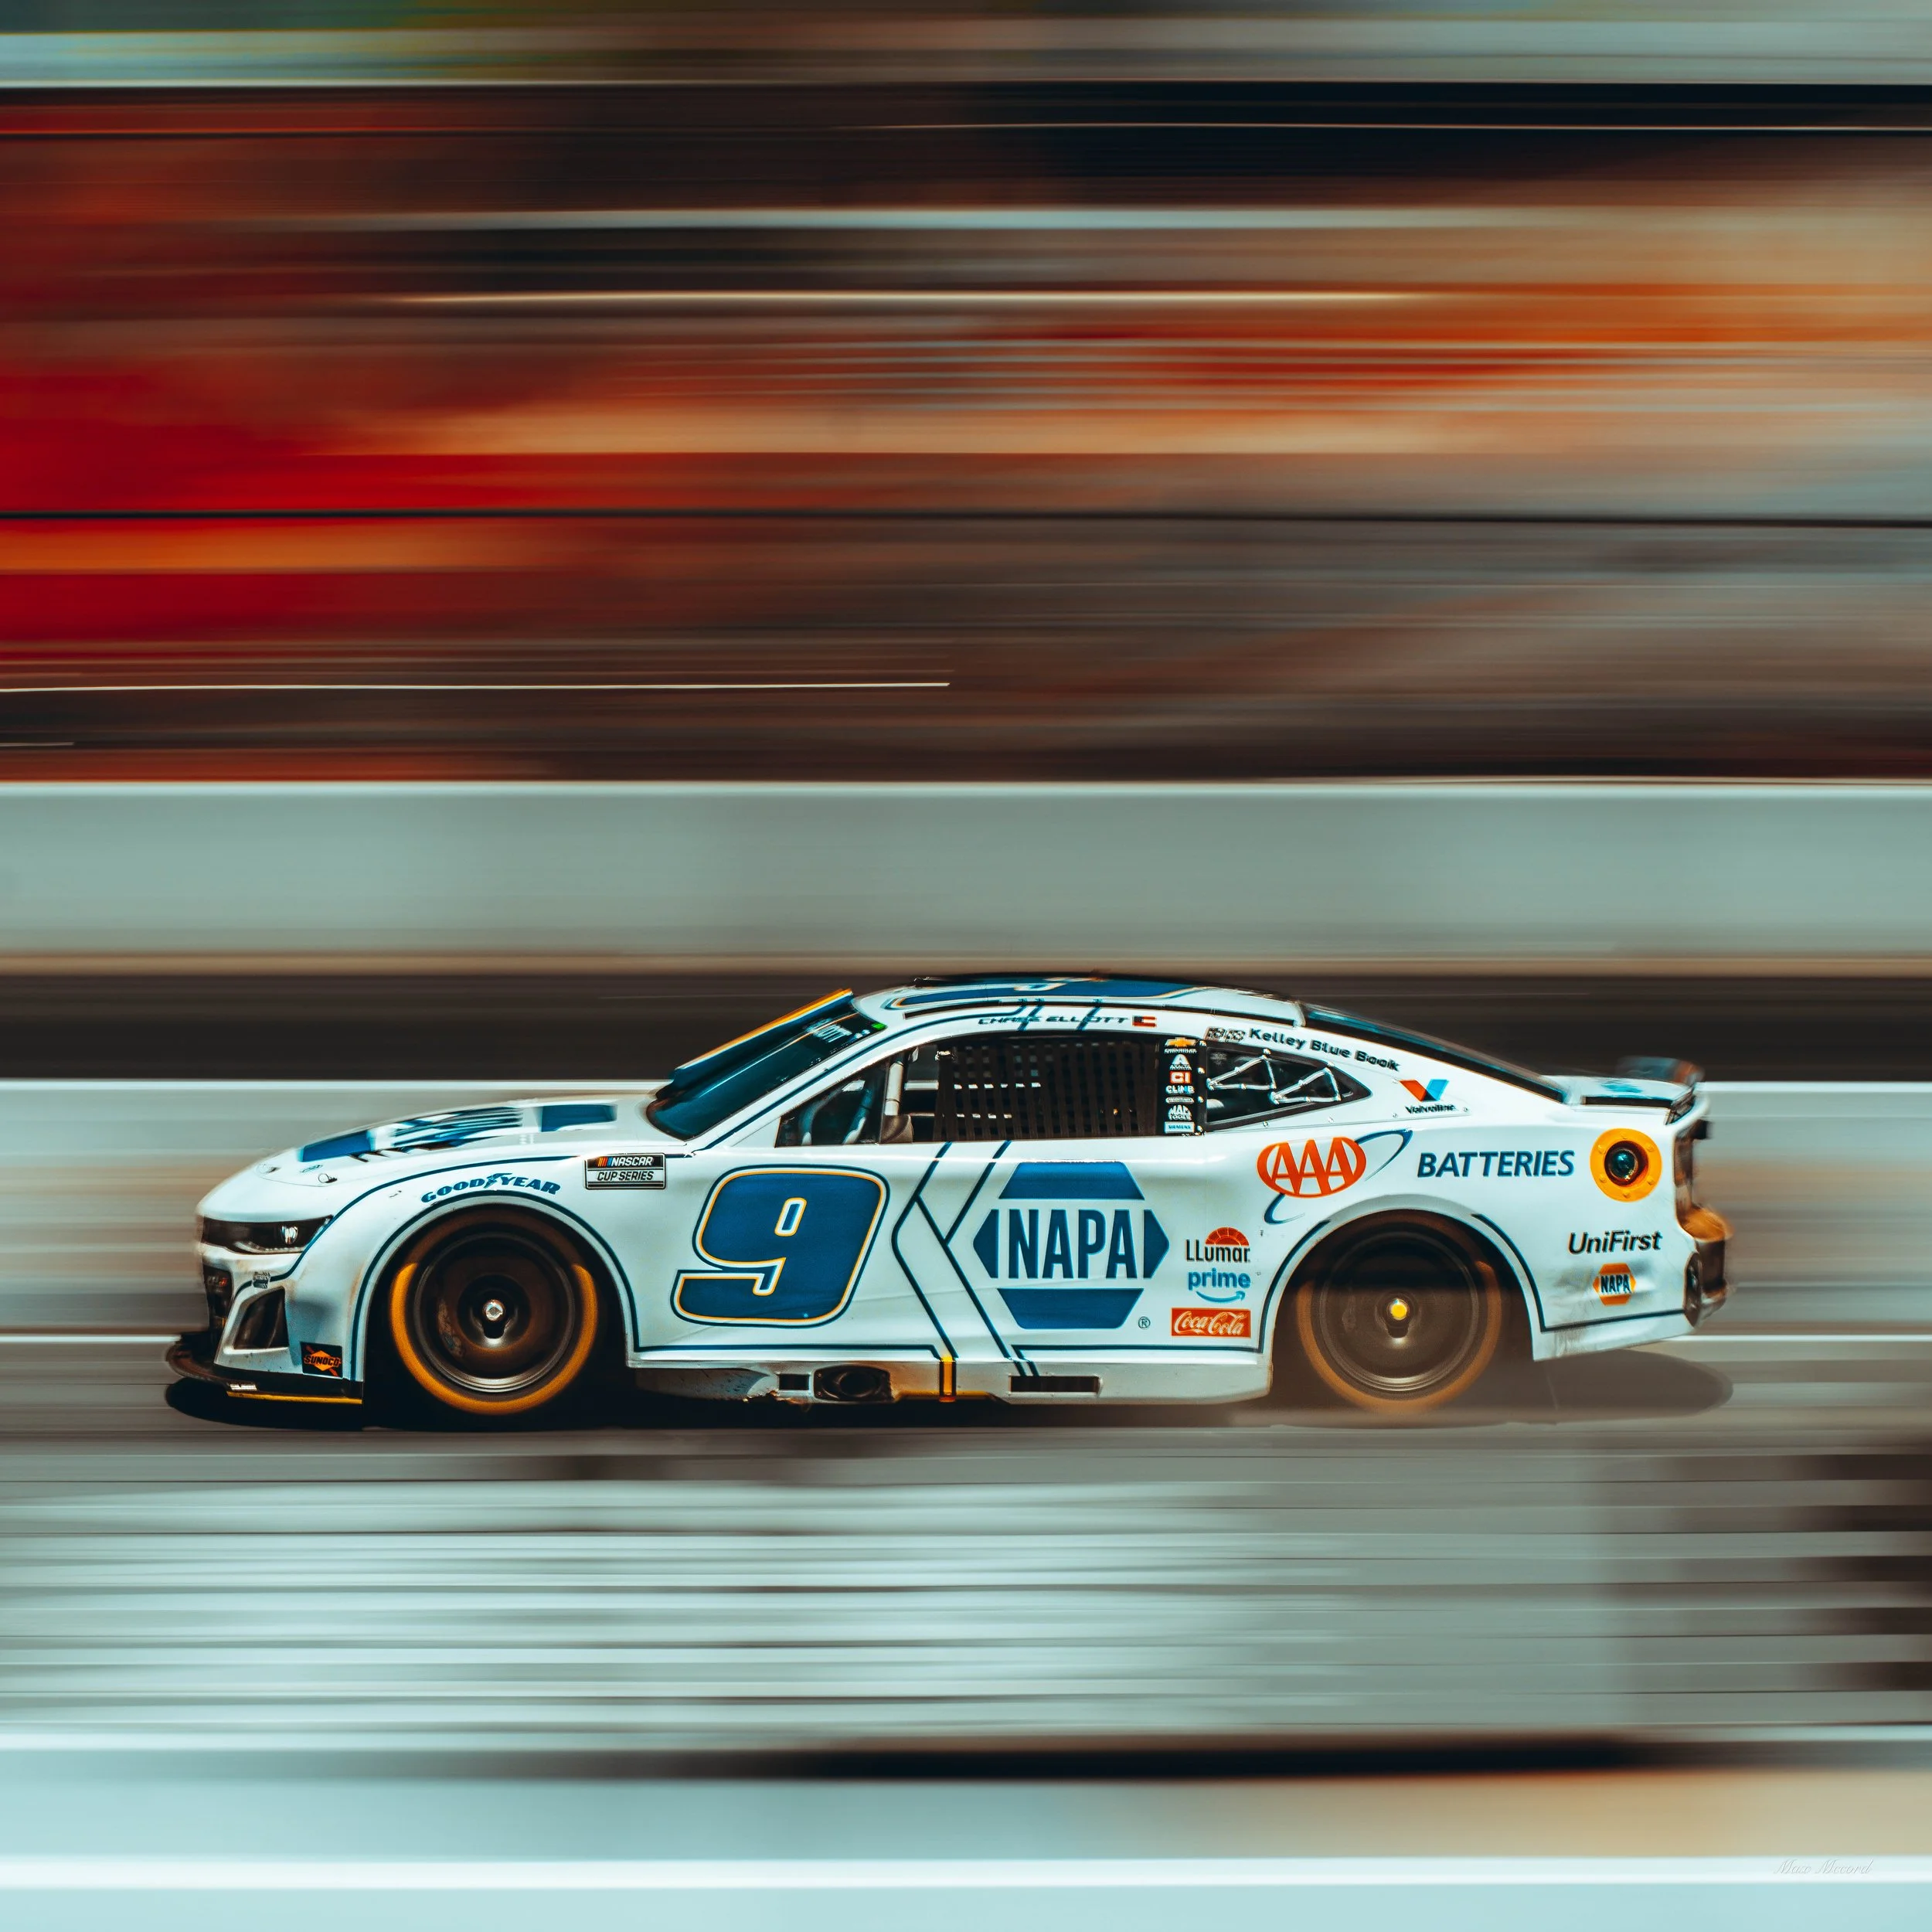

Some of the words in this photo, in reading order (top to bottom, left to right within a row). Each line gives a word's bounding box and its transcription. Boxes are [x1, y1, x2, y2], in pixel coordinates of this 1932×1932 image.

[978, 1015, 1041, 1026] CHASE
[1249, 1028, 1306, 1049] Kelley
[1309, 1039, 1352, 1058] Blue
[1355, 1049, 1401, 1071] Book
[1405, 1104, 1456, 1114] Valvoline
[611, 1156, 654, 1167] NASCAR
[1270, 1136, 1357, 1197] AAA
[1417, 1150, 1575, 1179] BATTERIES
[420, 1172, 561, 1203] GOODYEAR
[597, 1172, 617, 1181] CUP
[619, 1171, 655, 1181] SERIES
[671, 1164, 890, 1328] 9
[1009, 1209, 1138, 1279] NAPA
[1185, 1239, 1250, 1263] LLumar
[1568, 1230, 1663, 1255] UniFirst
[1188, 1267, 1251, 1291] prime
[1600, 1274, 1633, 1294] NAPA
[1174, 1311, 1247, 1336] Coca-Cola
[304, 1355, 340, 1367] SUNOCO
